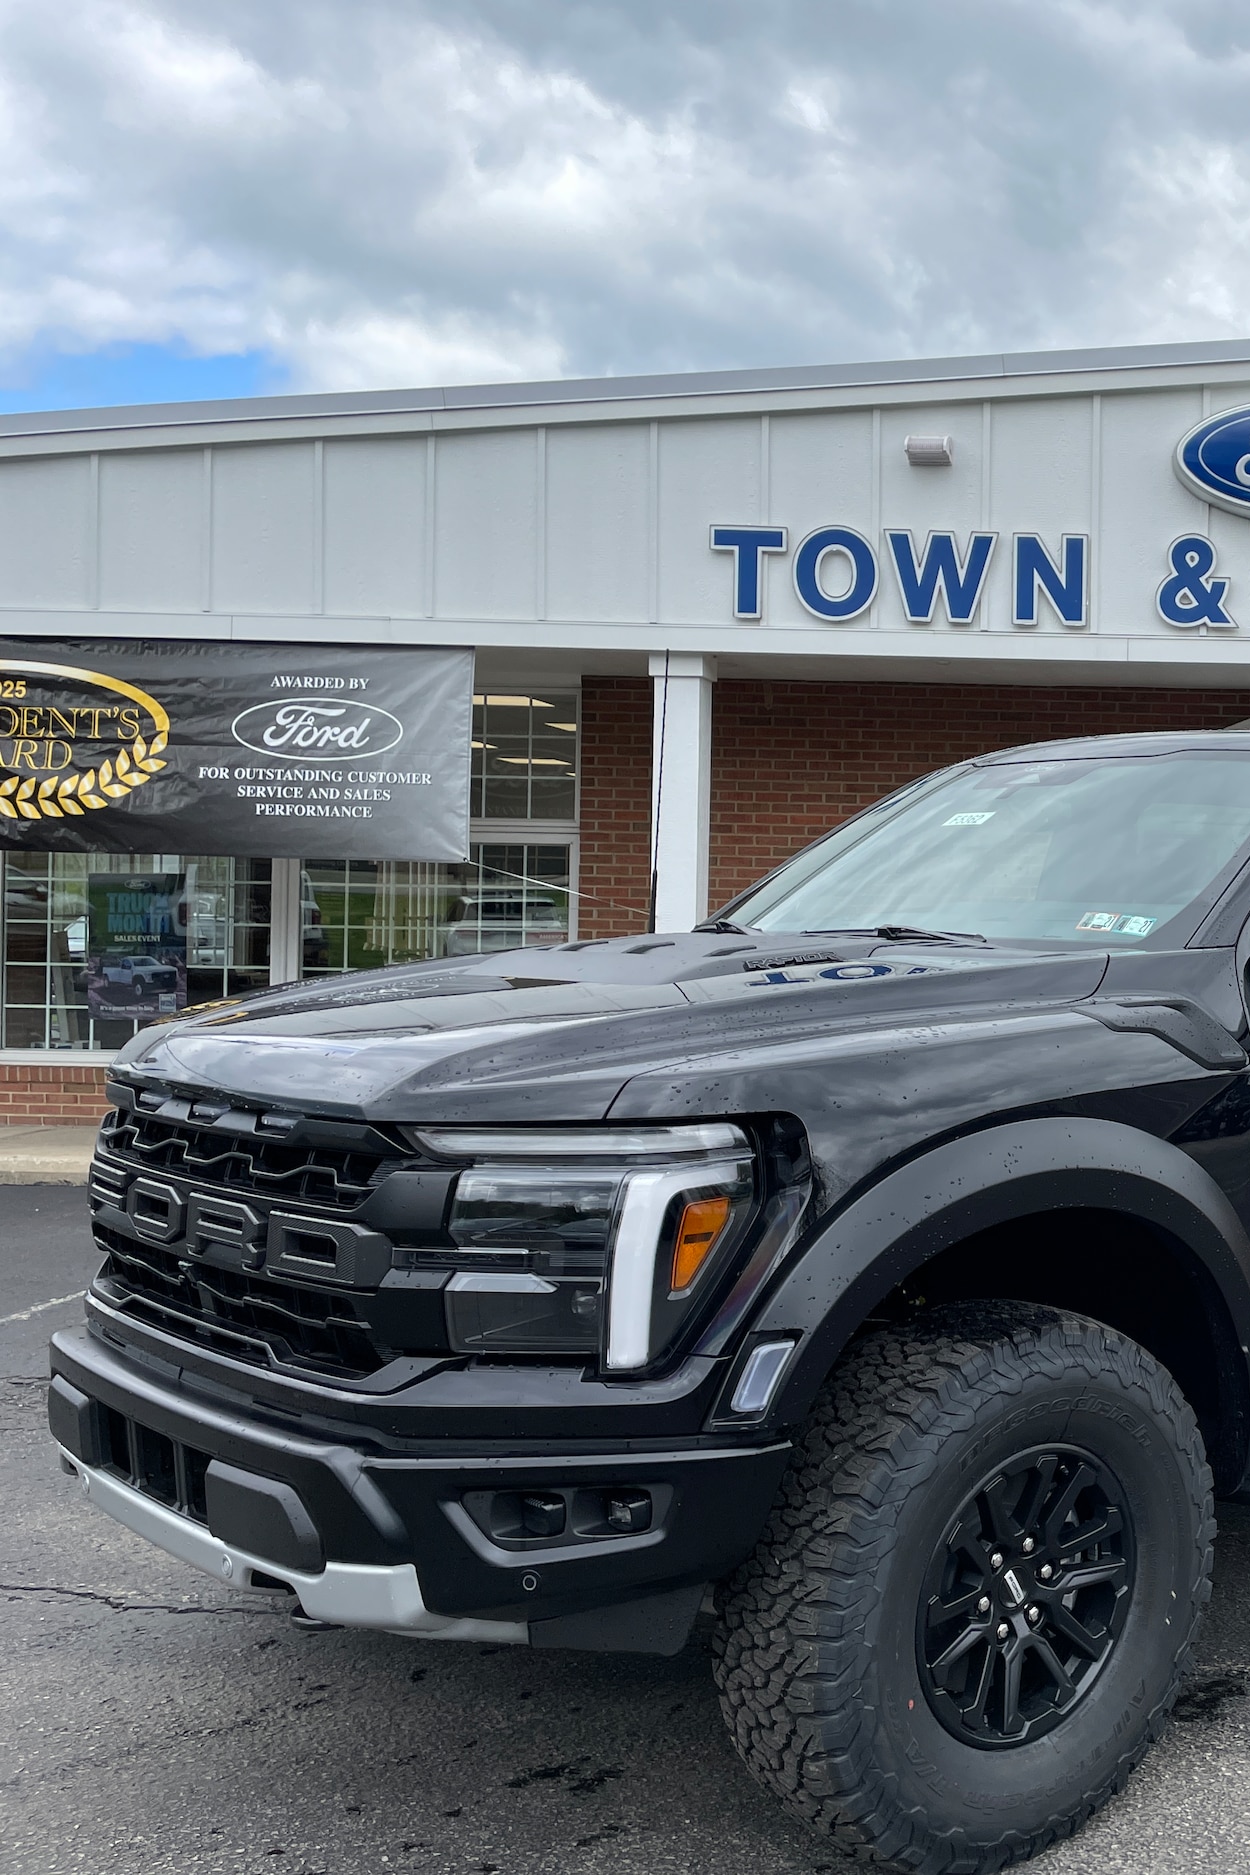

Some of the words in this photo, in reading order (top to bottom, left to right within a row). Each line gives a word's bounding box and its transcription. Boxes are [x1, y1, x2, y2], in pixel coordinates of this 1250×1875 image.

[709, 524, 1089, 627] TOWN
[1156, 533, 1239, 628] &
[0, 680, 27, 699] 25
[270, 676, 345, 689] AWARDED
[349, 677, 369, 690] BY
[262, 704, 372, 749] Ford
[198, 766, 230, 780] FOR
[234, 767, 343, 783] OUTSTANDING
[347, 770, 433, 785] CUSTOMER
[237, 785, 304, 799] SERVICE
[307, 787, 341, 800] AND
[343, 788, 392, 801] SALES
[255, 803, 374, 819] PERFORMANCE
[106, 892, 170, 913] TRUCK
[107, 914, 170, 933] MONTH
[746, 952, 840, 970] RAPTOR
[88, 1160, 380, 1294] FORD
